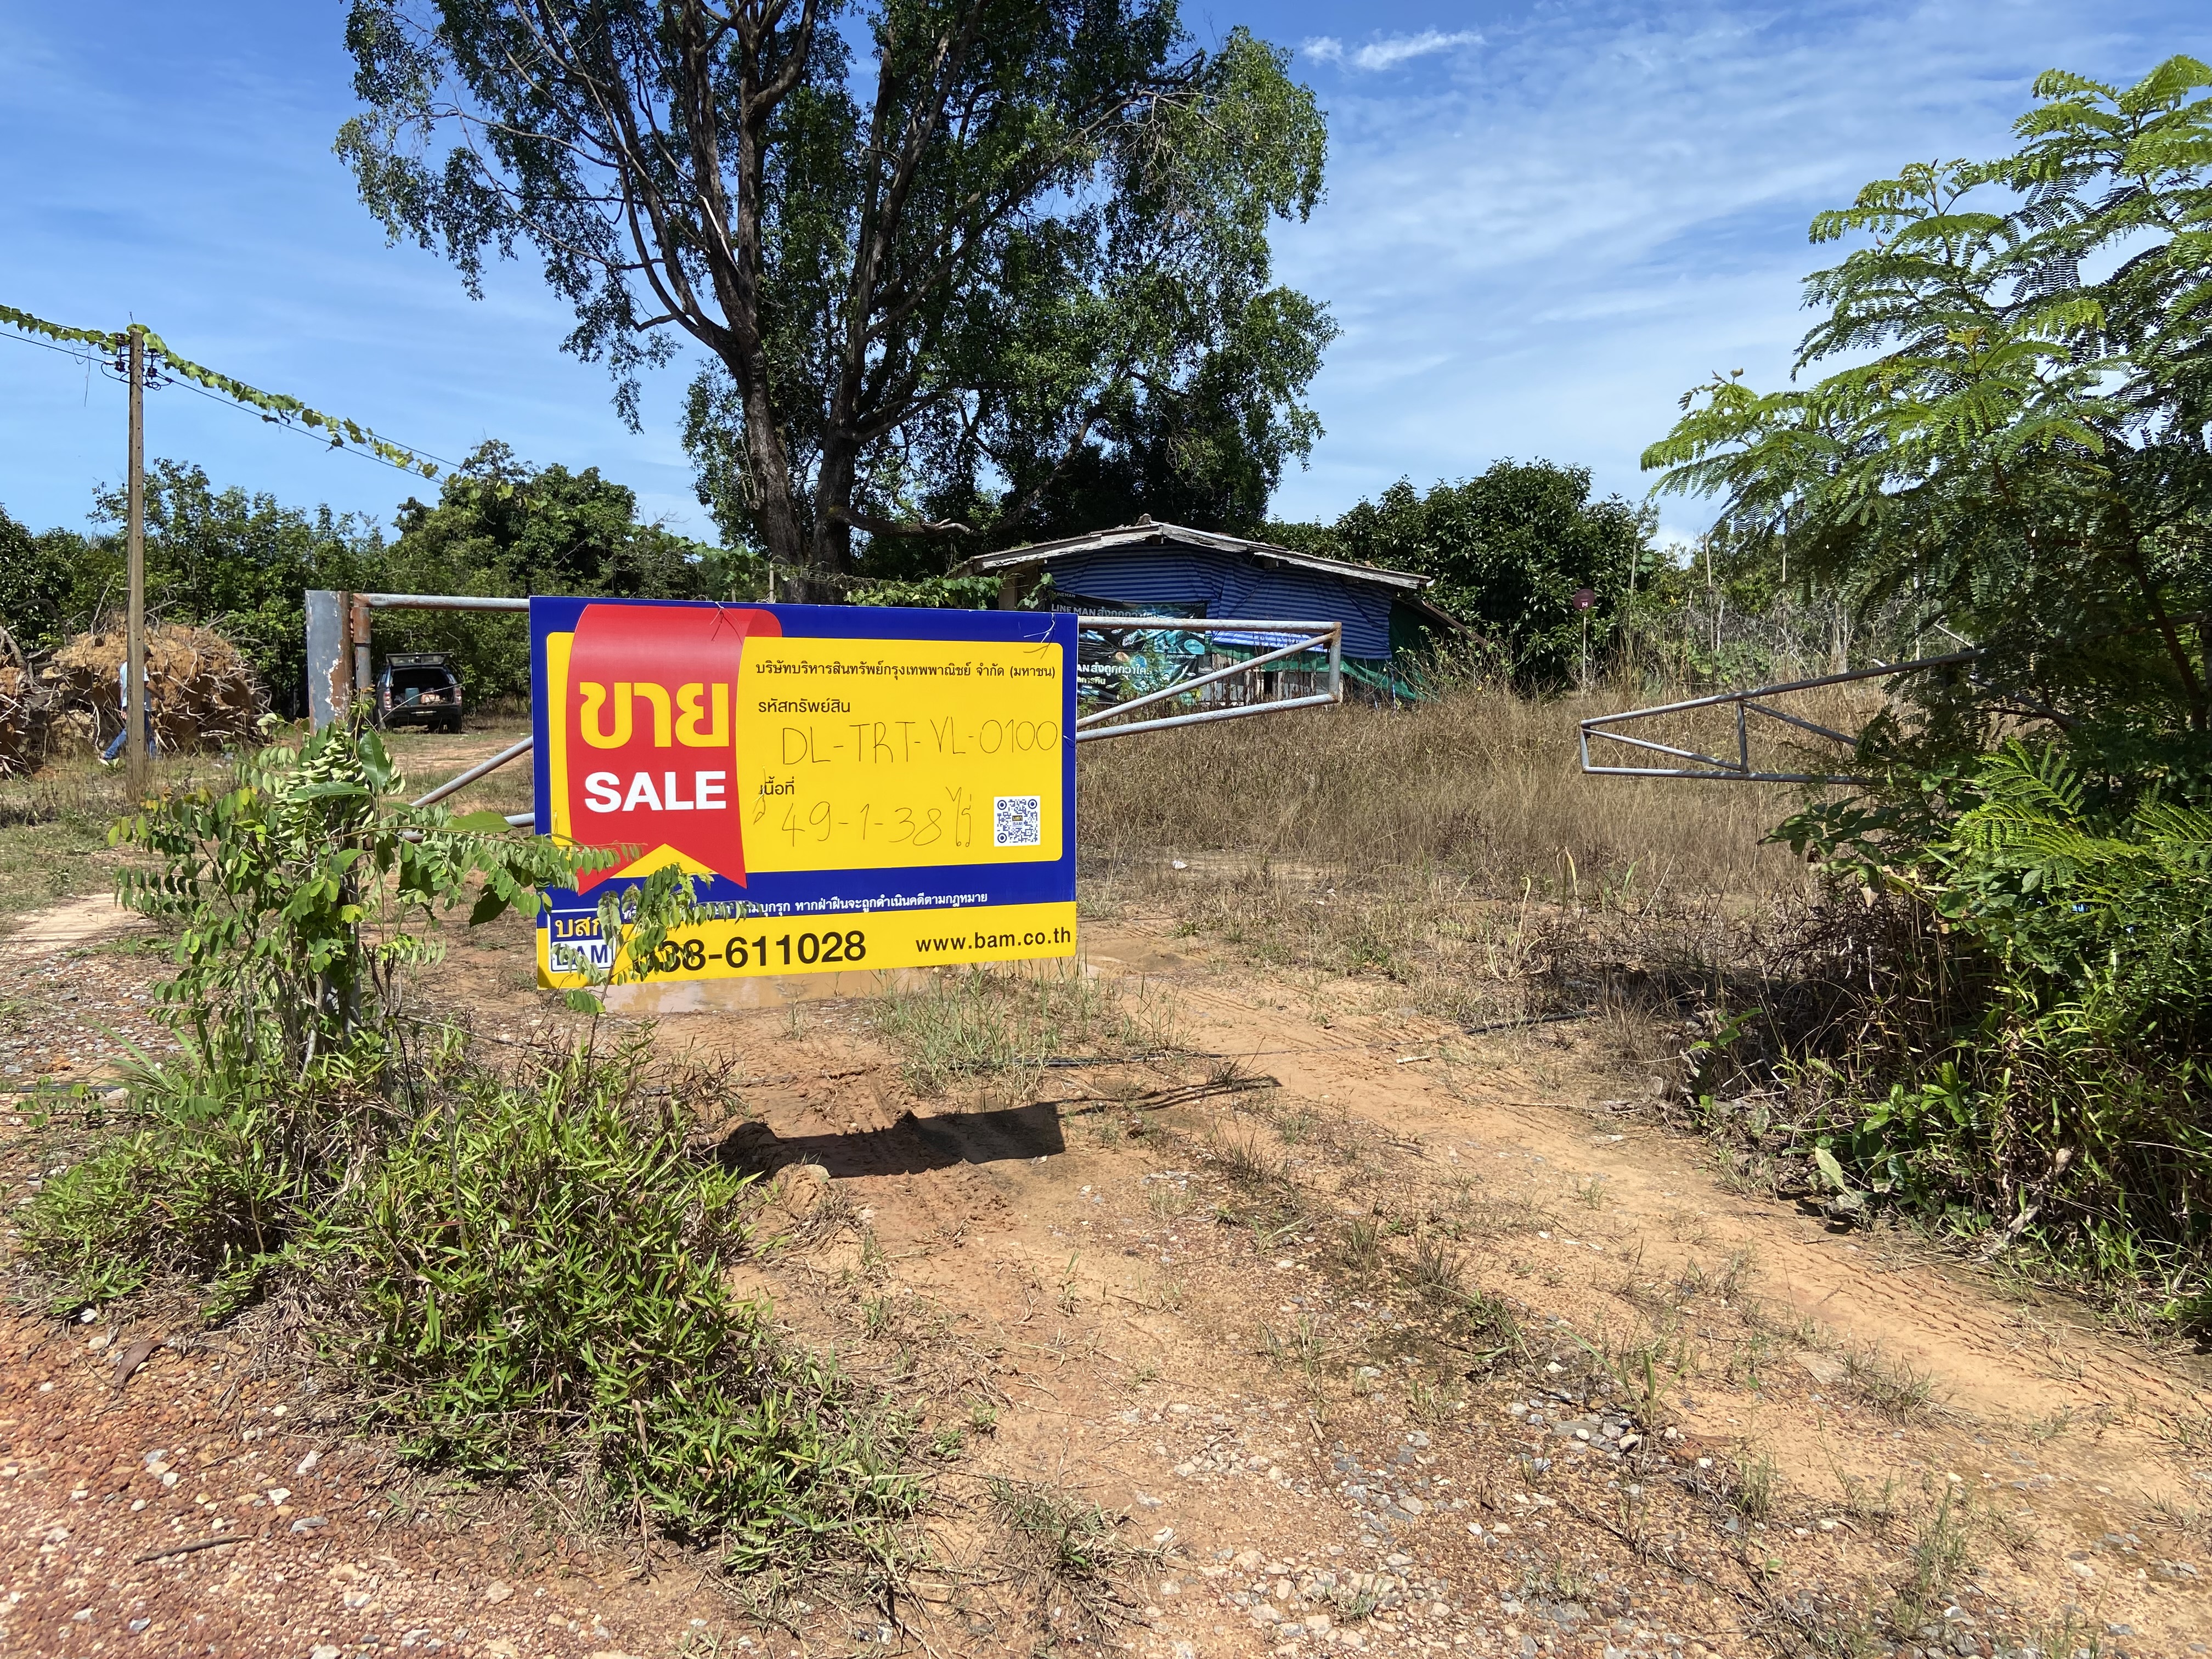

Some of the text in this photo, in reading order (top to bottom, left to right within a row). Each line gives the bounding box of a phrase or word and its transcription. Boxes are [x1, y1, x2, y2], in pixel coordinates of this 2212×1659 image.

[1051, 603, 1071, 613] LINE
[1074, 607, 1096, 617] MAN
[755, 660, 1055, 680] บริษัทบริหารสินทรัพย์กรุงเทพพาณิชย์ จำกัด (มหาชน)
[1077, 664, 1090, 673] AN
[579, 682, 730, 749] ขาย
[758, 698, 850, 713] รหัสทรัพย์สิน
[585, 771, 726, 813] SALE
[756, 776, 794, 795] เนื้อที่
[795, 892, 988, 913] หากฝ่าฝืนจะถูกดำเนินคดีตามกฎหมาย
[916, 927, 1071, 952] www.bam.co.th
